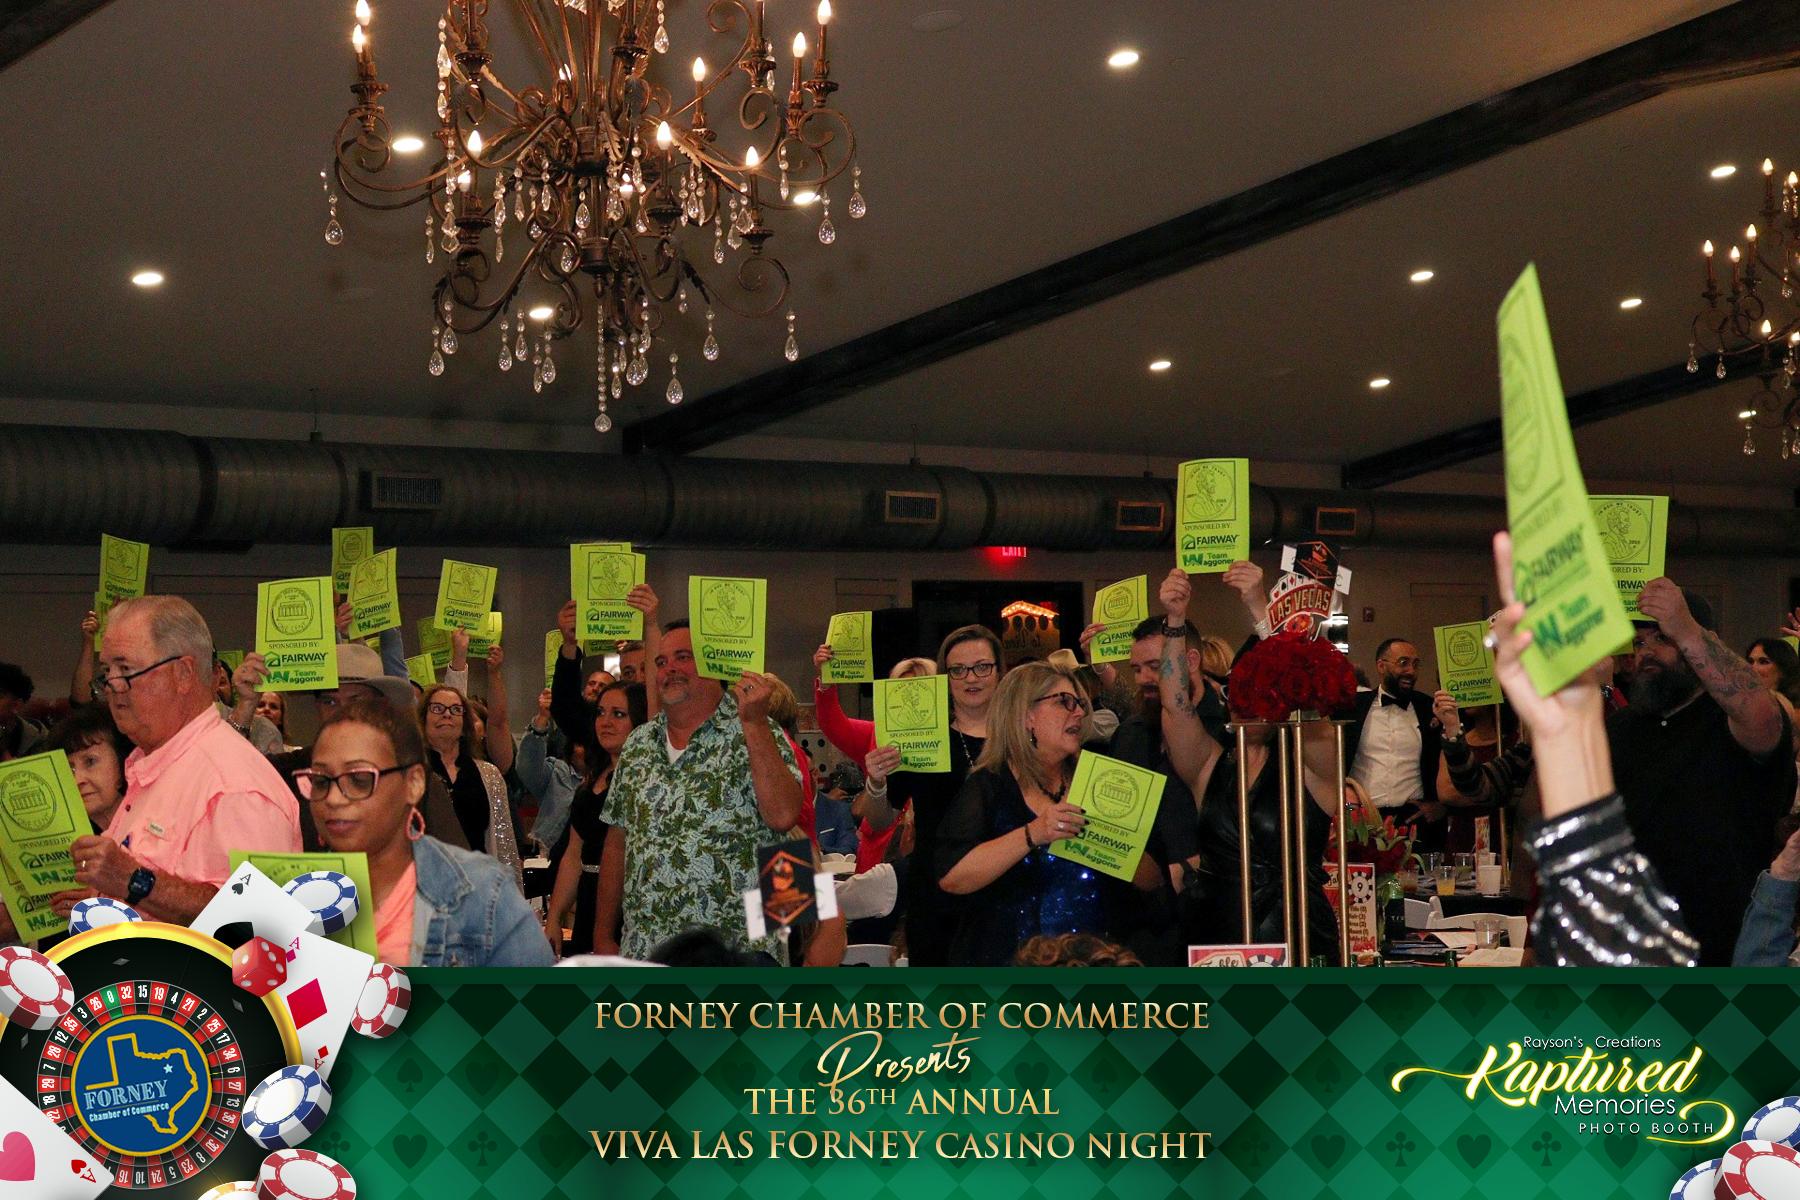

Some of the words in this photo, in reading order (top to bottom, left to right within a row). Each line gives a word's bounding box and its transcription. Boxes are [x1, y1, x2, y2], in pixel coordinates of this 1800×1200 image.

[1196, 535, 1238, 544] FAIRWAY
[1618, 580, 1645, 589] IRWA
[364, 602, 391, 614] FAIRWAY
[1270, 597, 1292, 625] LAS
[1294, 589, 1331, 611] VEGAS
[455, 610, 484, 618] FAIRWAY
[281, 652, 327, 662] FAIRWAY
[716, 649, 754, 659] FAIRWAY
[1460, 678, 1492, 688] FAIRWAY
[902, 741, 941, 749] FAIRWAY
[1087, 830, 1135, 853] FAIRWAY
[1094, 849, 1116, 862] Team
[1357, 882, 1363, 892] 9
